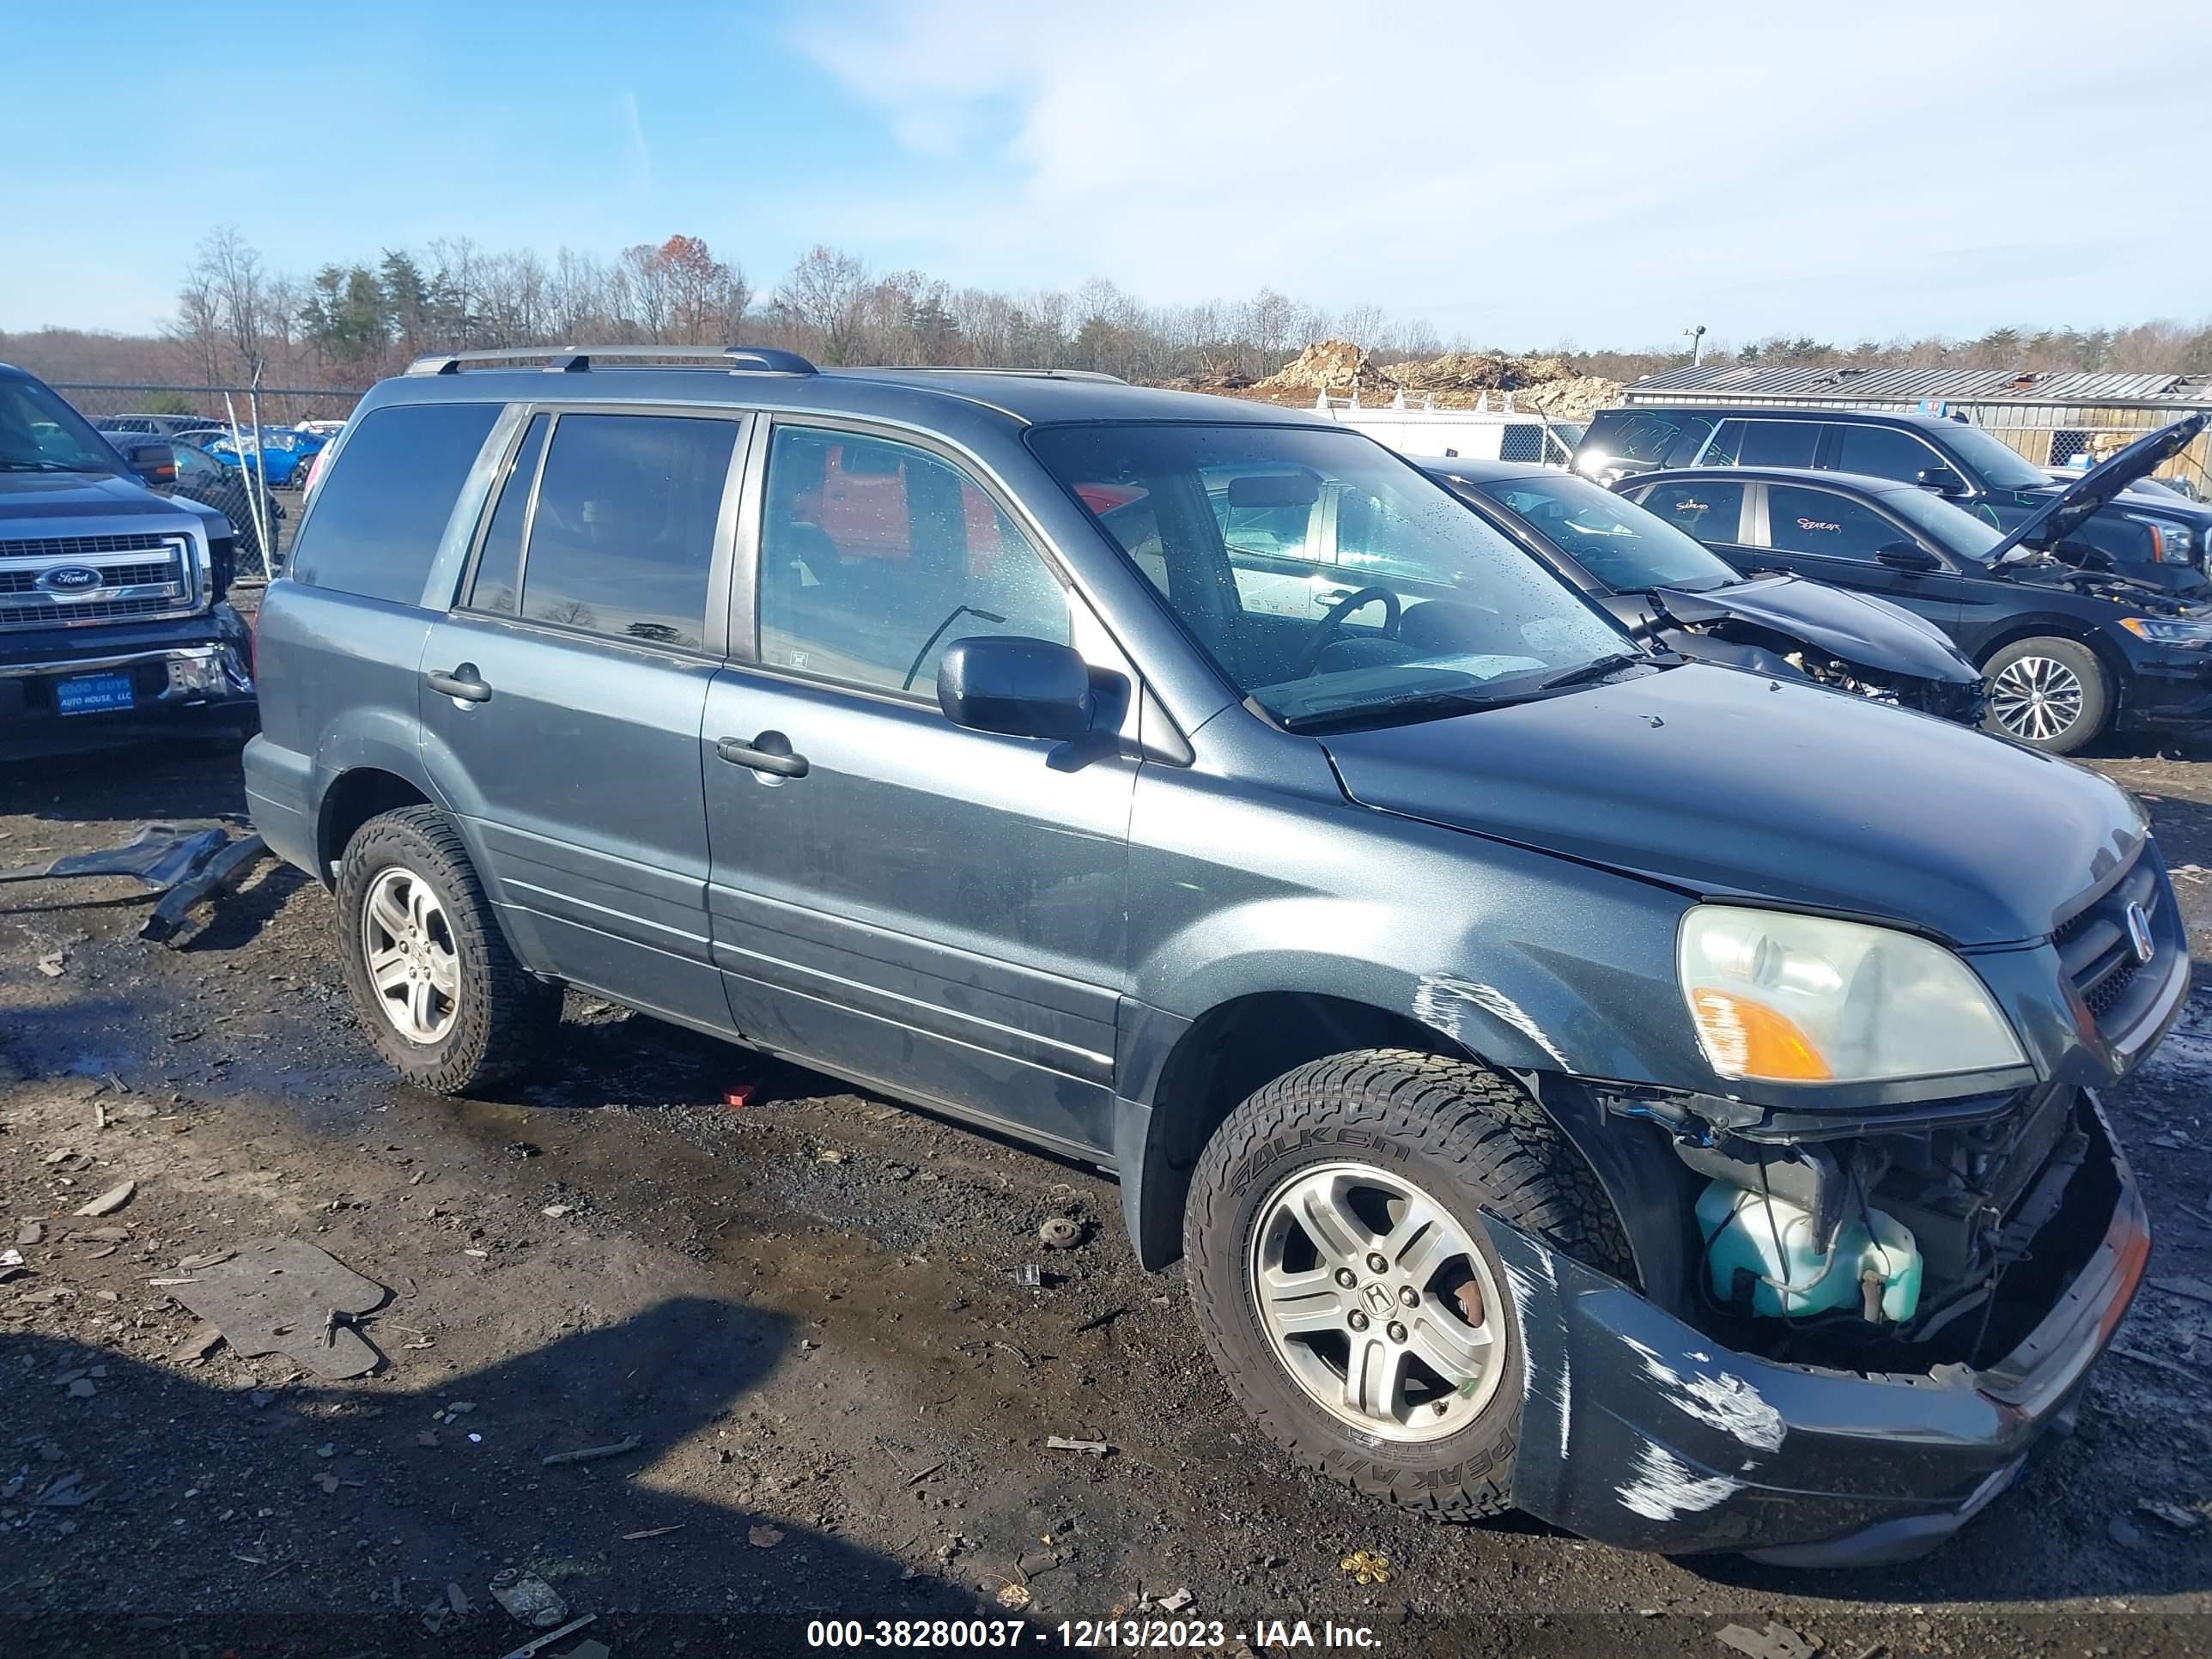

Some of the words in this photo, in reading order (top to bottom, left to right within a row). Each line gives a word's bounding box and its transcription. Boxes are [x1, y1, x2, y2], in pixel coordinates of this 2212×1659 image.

[57, 571, 89, 585] Ford
[61, 697, 82, 707] AUTO
[117, 691, 131, 701] LLC
[1231, 1127, 1411, 1197] FALKEN
